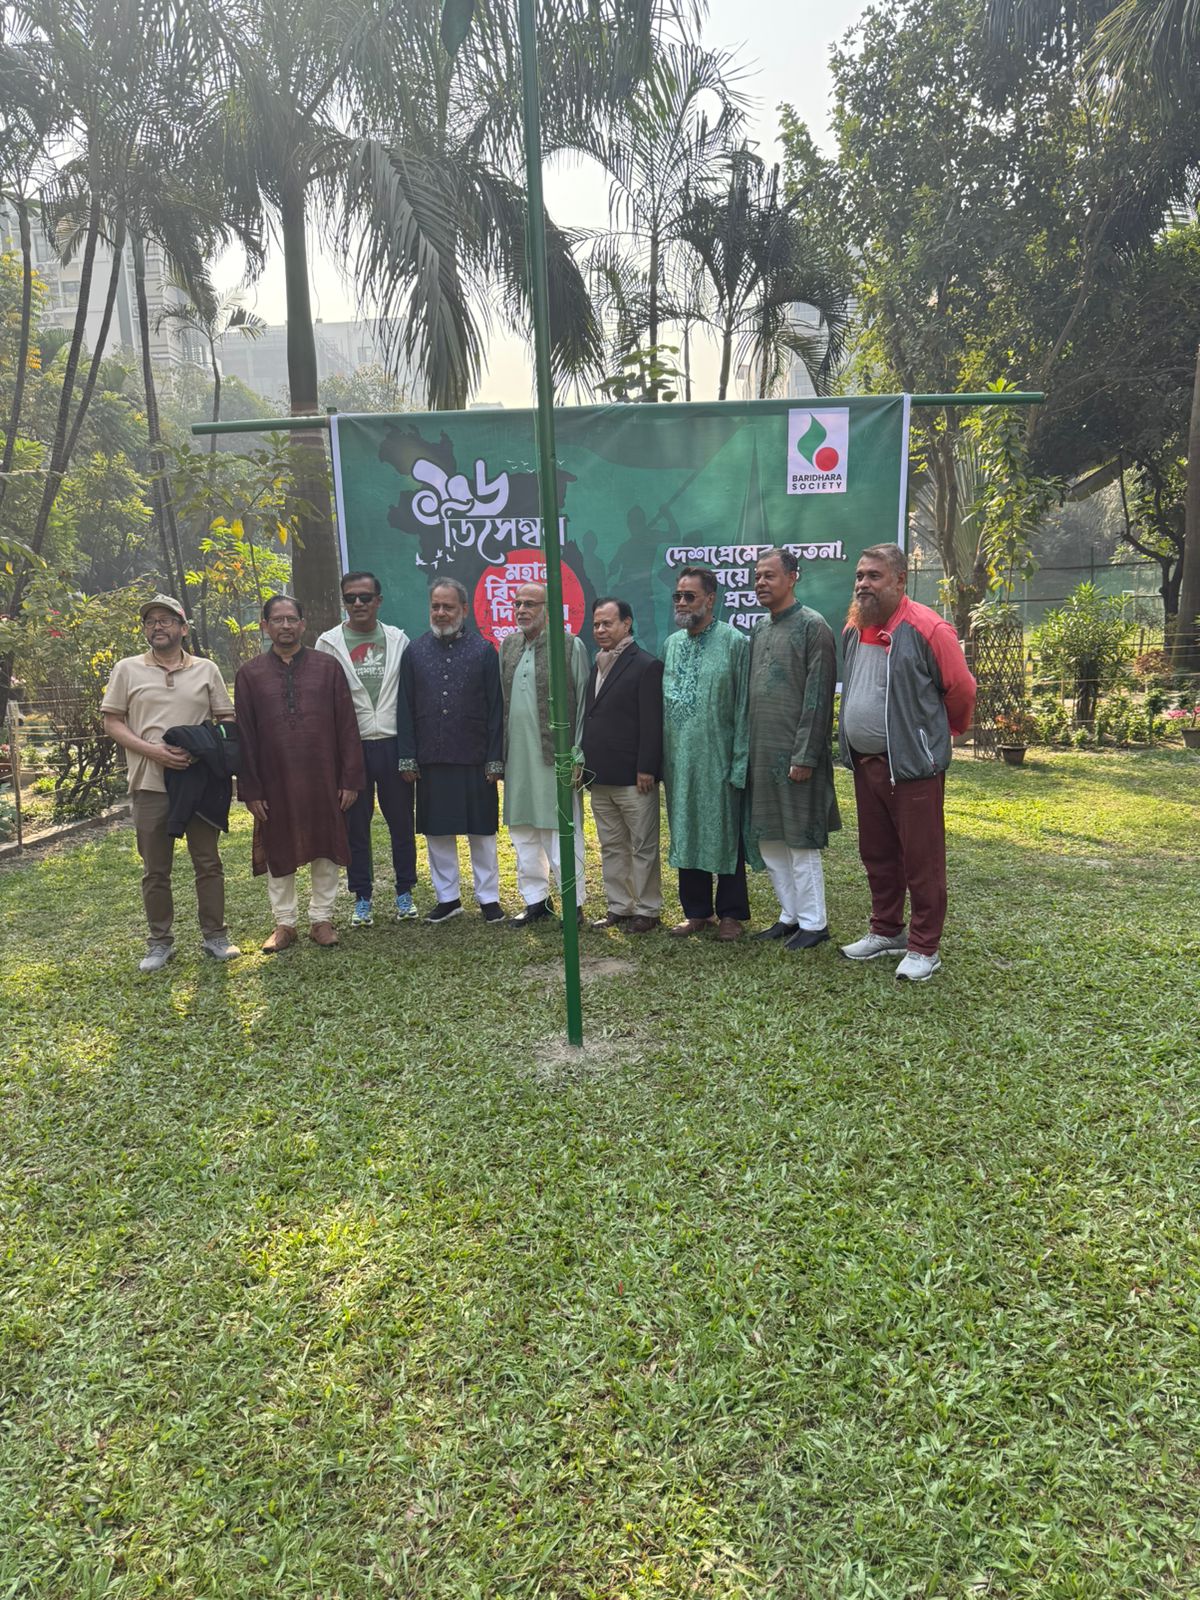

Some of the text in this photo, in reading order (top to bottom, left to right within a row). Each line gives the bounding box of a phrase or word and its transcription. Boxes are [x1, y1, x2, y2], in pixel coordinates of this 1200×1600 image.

[792, 474, 842, 482] BARIDHARA
[792, 482, 842, 490] SOCIETY
[412, 459, 509, 525] ১৬
